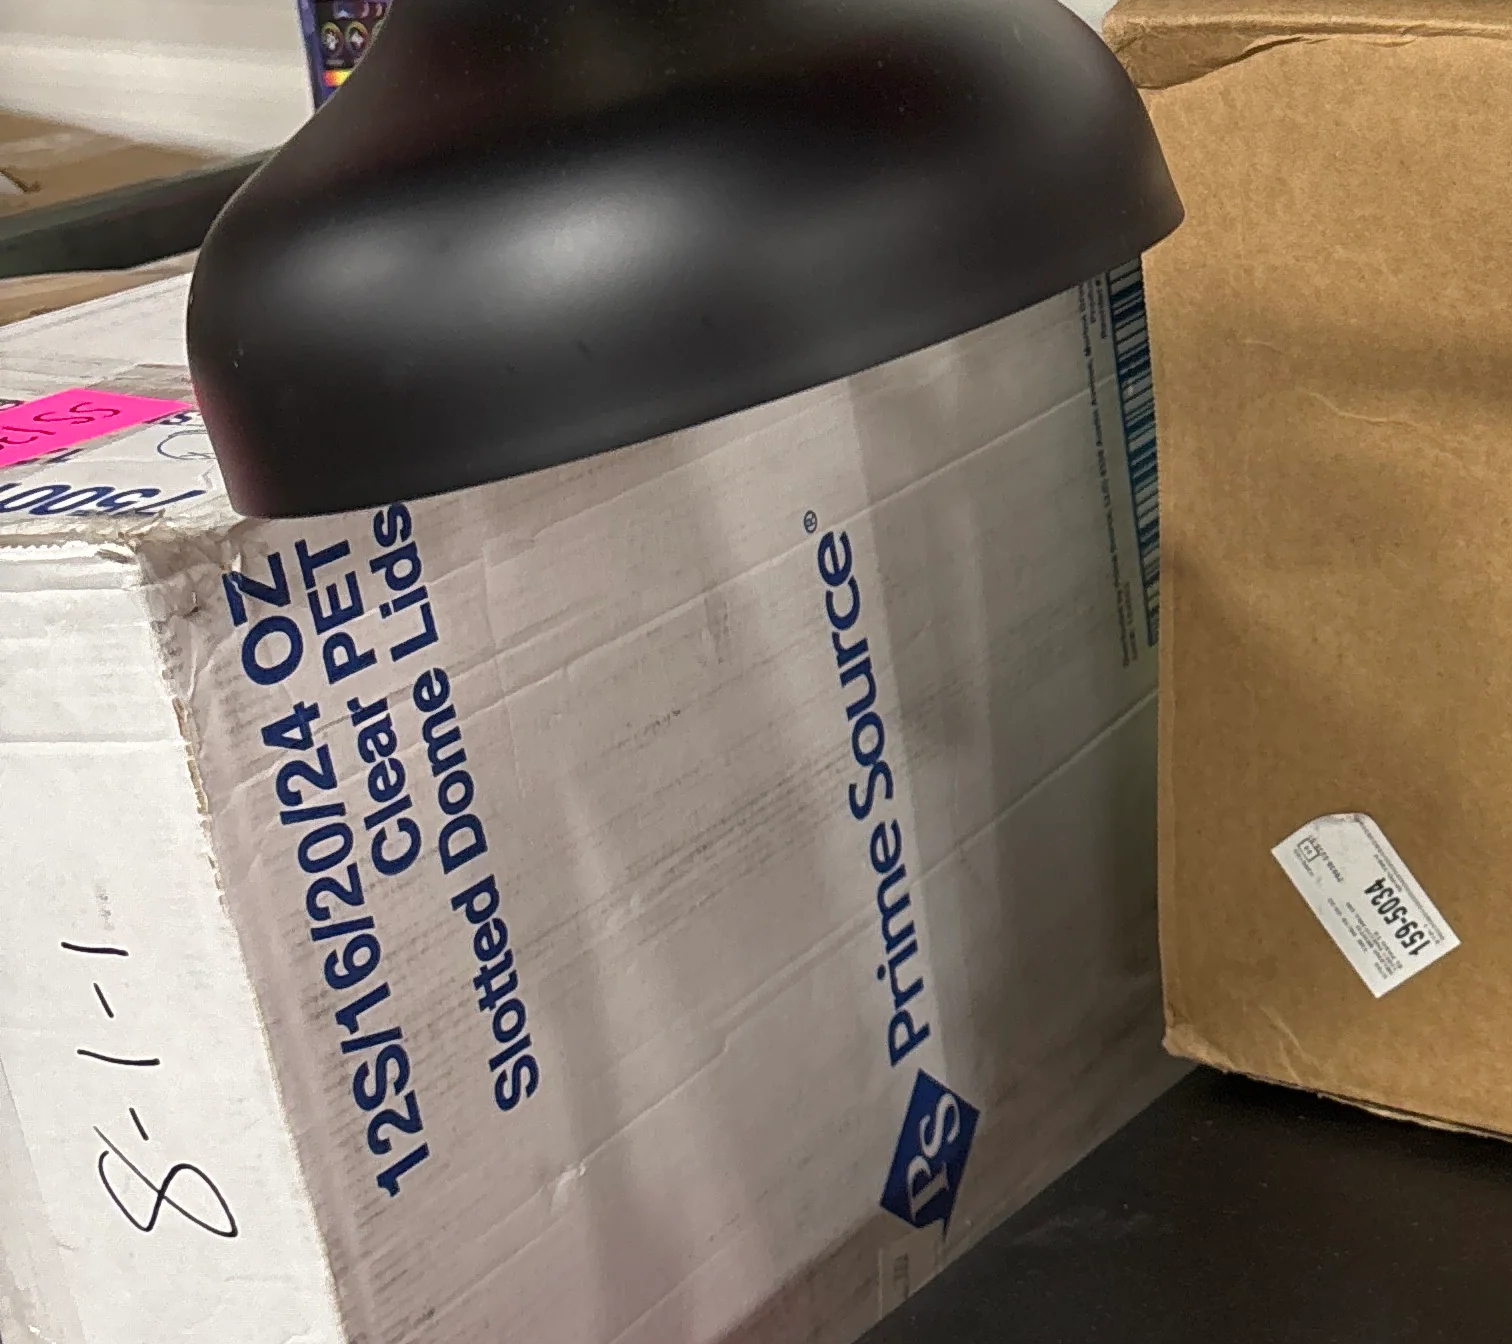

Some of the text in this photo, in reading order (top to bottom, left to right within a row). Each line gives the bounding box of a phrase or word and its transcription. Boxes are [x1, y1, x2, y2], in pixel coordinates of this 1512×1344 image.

[222, 552, 303, 686] OZ
[295, 539, 422, 875] Clear PET
[369, 503, 539, 1112] Slotted Dome Lids
[869, 819, 930, 1068] Prime
[1364, 877, 1430, 956] 159-5034
[909, 1091, 961, 1226] PS
